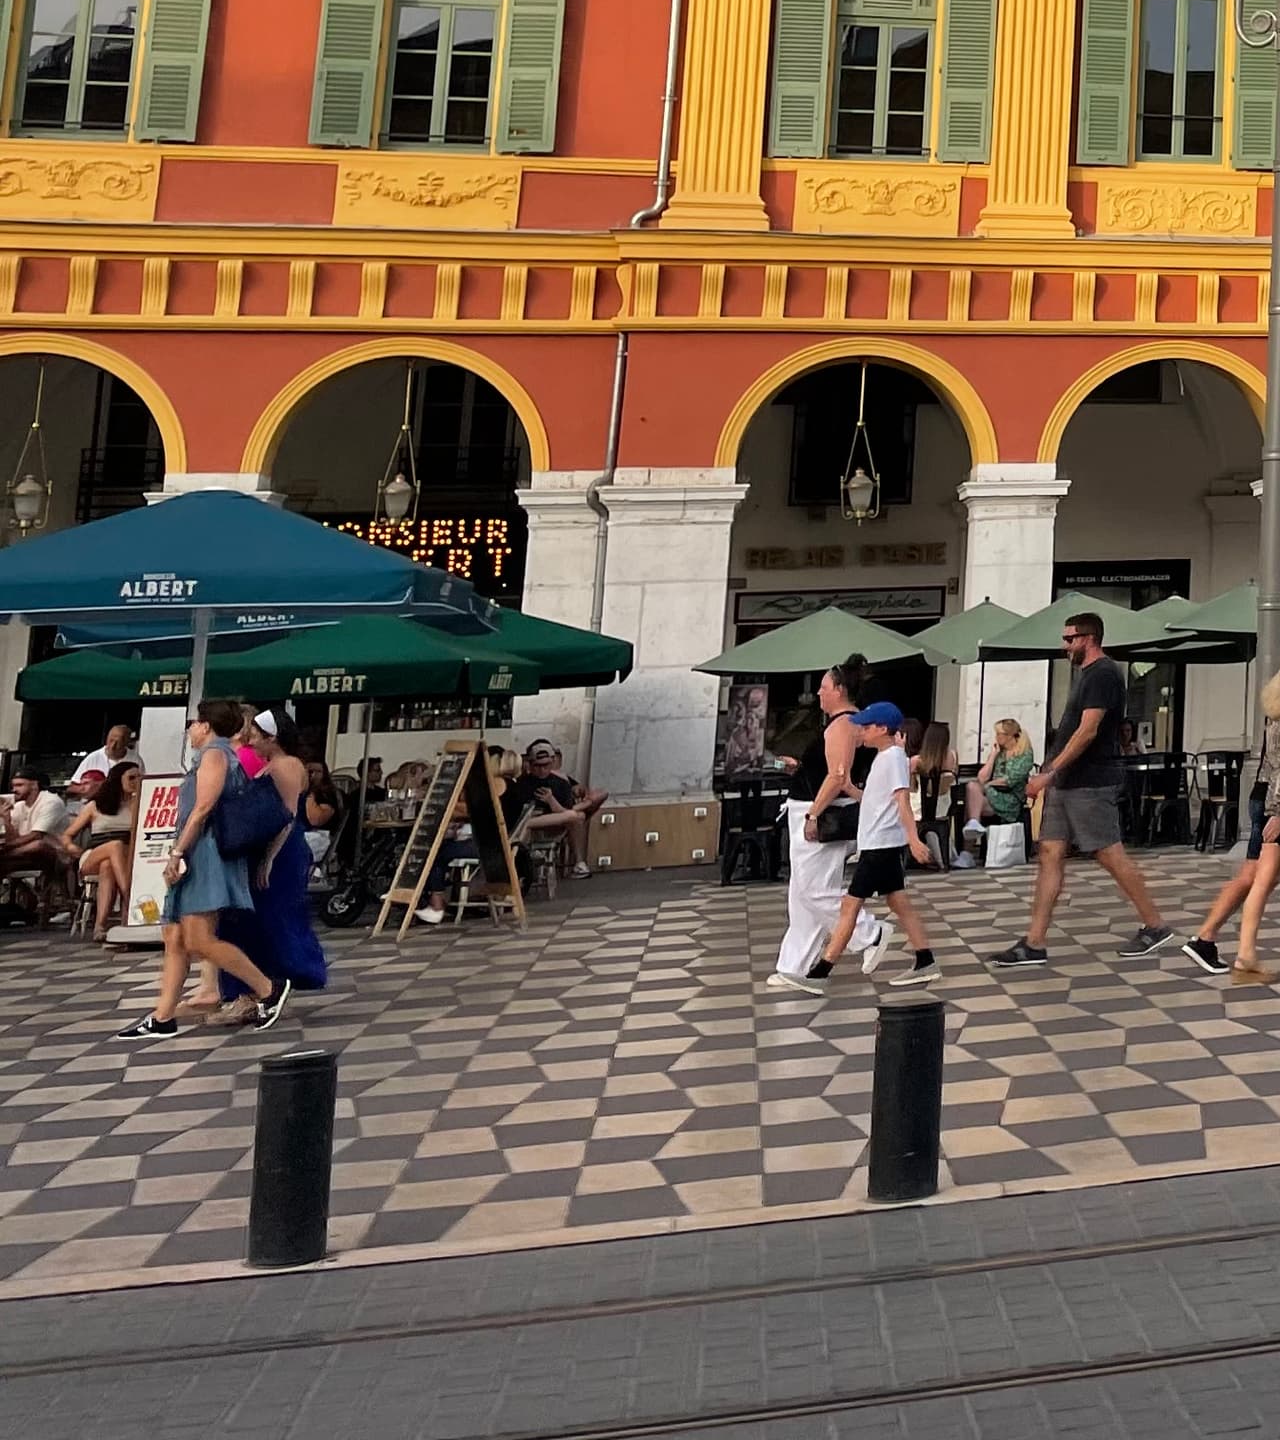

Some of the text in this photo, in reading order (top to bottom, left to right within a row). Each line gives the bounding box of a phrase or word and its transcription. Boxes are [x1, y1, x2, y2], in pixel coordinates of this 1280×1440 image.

[120, 580, 199, 598] ALBERT
[139, 680, 190, 696] ALBE
[290, 674, 368, 695] ALBERT
